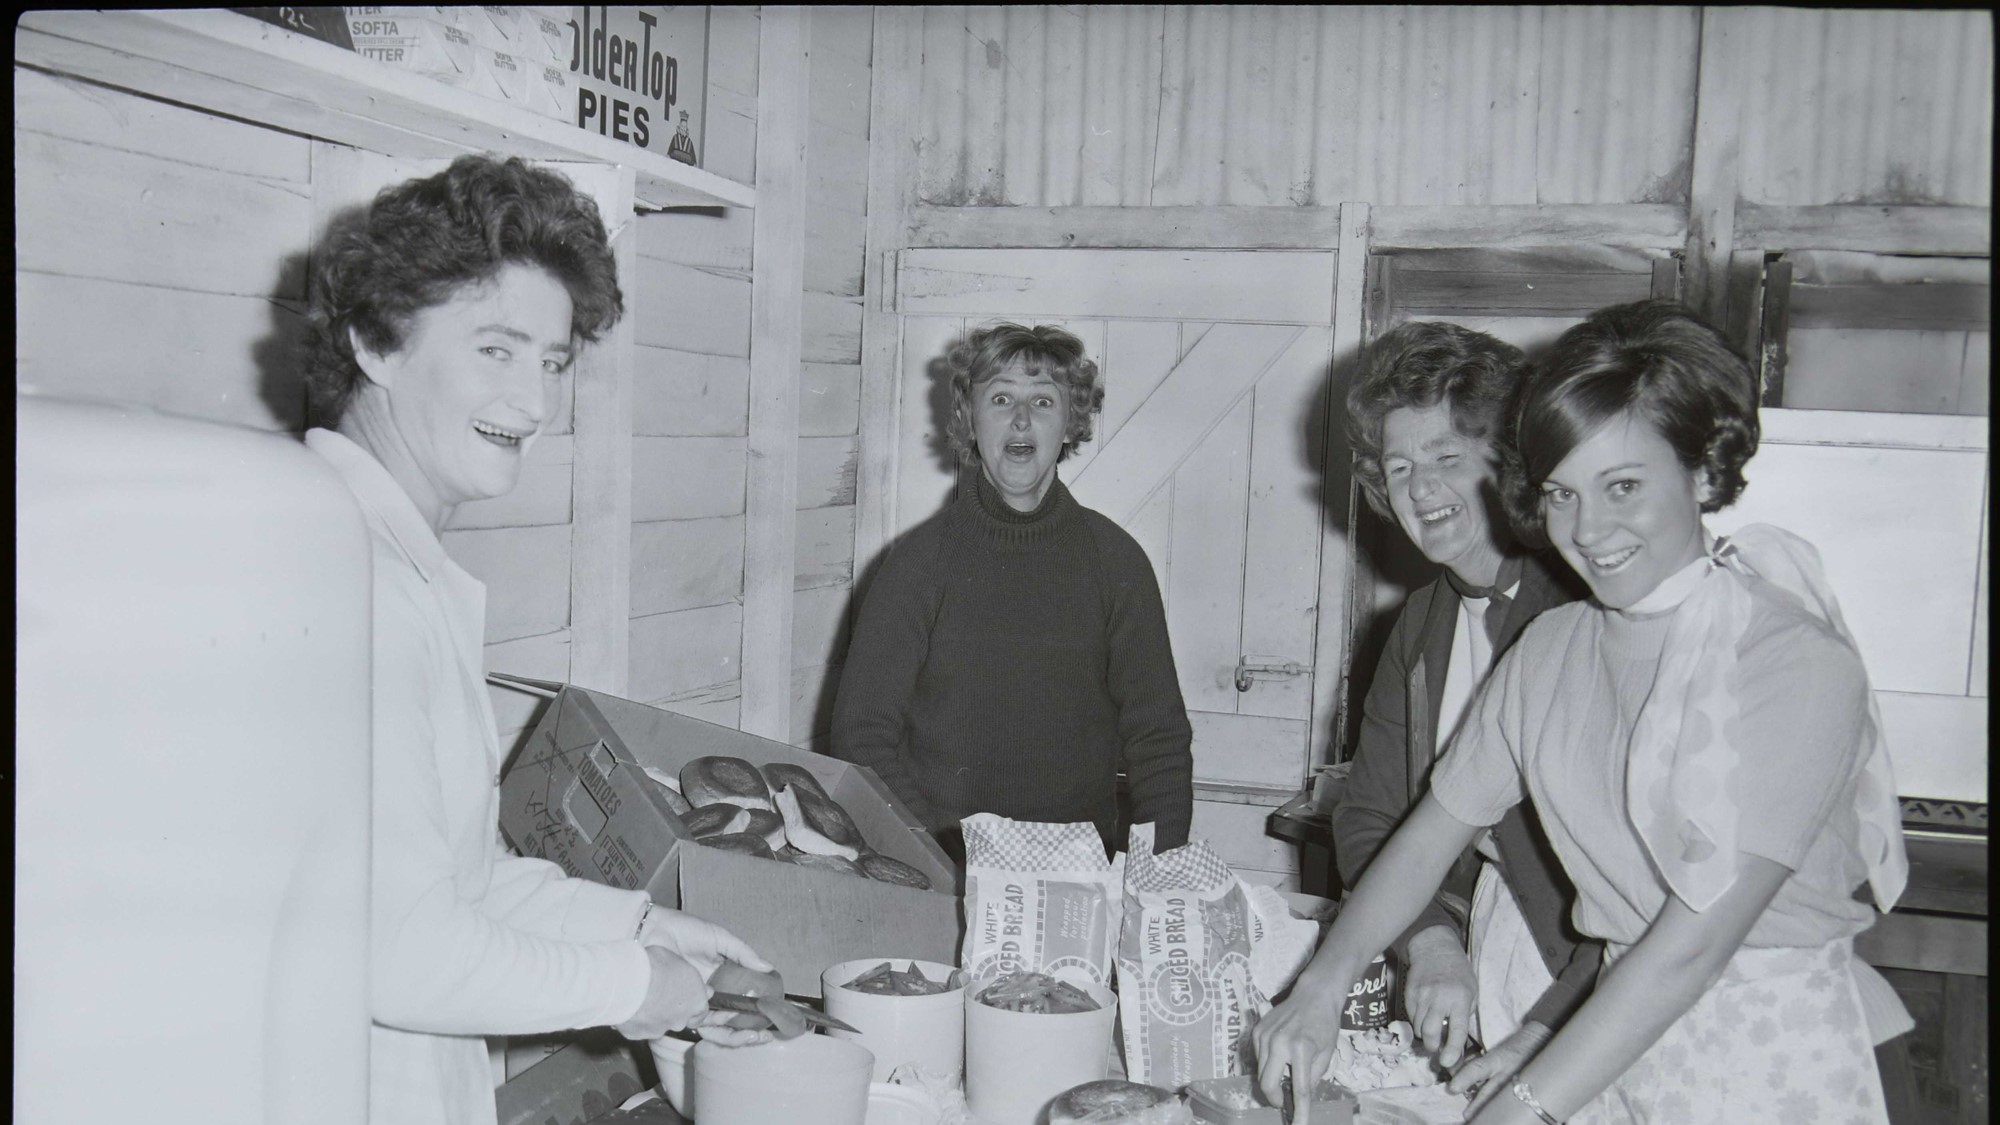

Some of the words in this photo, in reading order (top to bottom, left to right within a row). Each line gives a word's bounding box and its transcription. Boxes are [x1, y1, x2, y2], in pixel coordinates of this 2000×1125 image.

[352, 21, 399, 36] SOFTA
[494, 58, 517, 72] BUTTER
[495, 51, 513, 63] SOFTA
[543, 73, 566, 87] BUTTER
[578, 87, 650, 148] PIES
[576, 753, 622, 816] TOMATOES
[600, 855, 614, 875] 15
[984, 902, 999, 945] WHITE
[1003, 884, 1024, 936] BREAD
[1165, 898, 1186, 945] BREAD
[1148, 916, 1162, 955] WHITE
[1169, 948, 1193, 1006] SLICED
[1181, 1040, 1192, 1083] Wrapped
